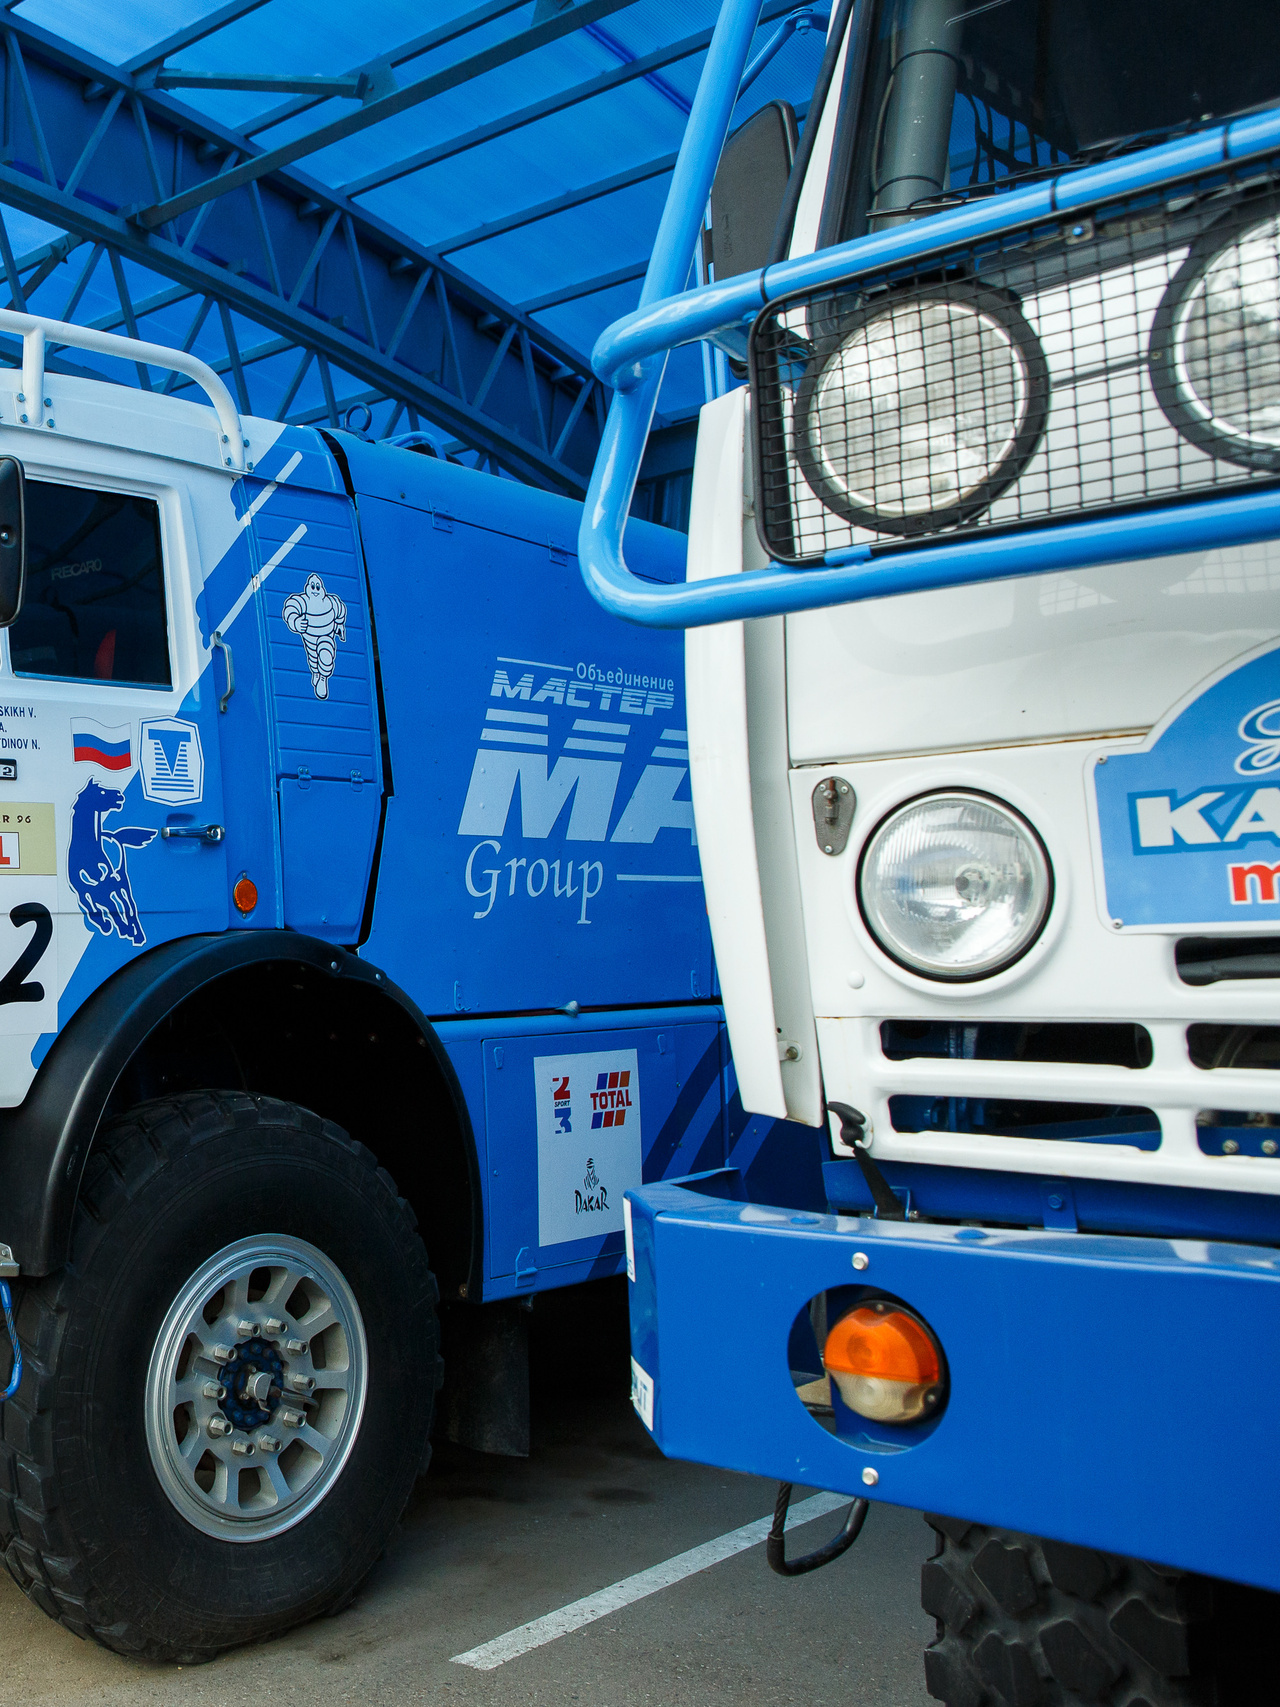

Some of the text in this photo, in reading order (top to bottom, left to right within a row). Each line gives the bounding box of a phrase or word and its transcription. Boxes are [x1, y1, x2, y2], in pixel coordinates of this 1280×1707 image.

[50, 558, 102, 580] RECARO
[576, 662, 675, 691] Объединение
[28, 707, 37, 718] V.
[31, 739, 41, 750] N.
[16, 814, 32, 824] 96
[465, 840, 604, 925] Group
[552, 1076, 570, 1100] 2
[554, 1100, 570, 1108] SPORT
[590, 1089, 632, 1111] TOTAL
[554, 1107, 572, 1134] 3
[574, 1186, 610, 1215] DAKAR
